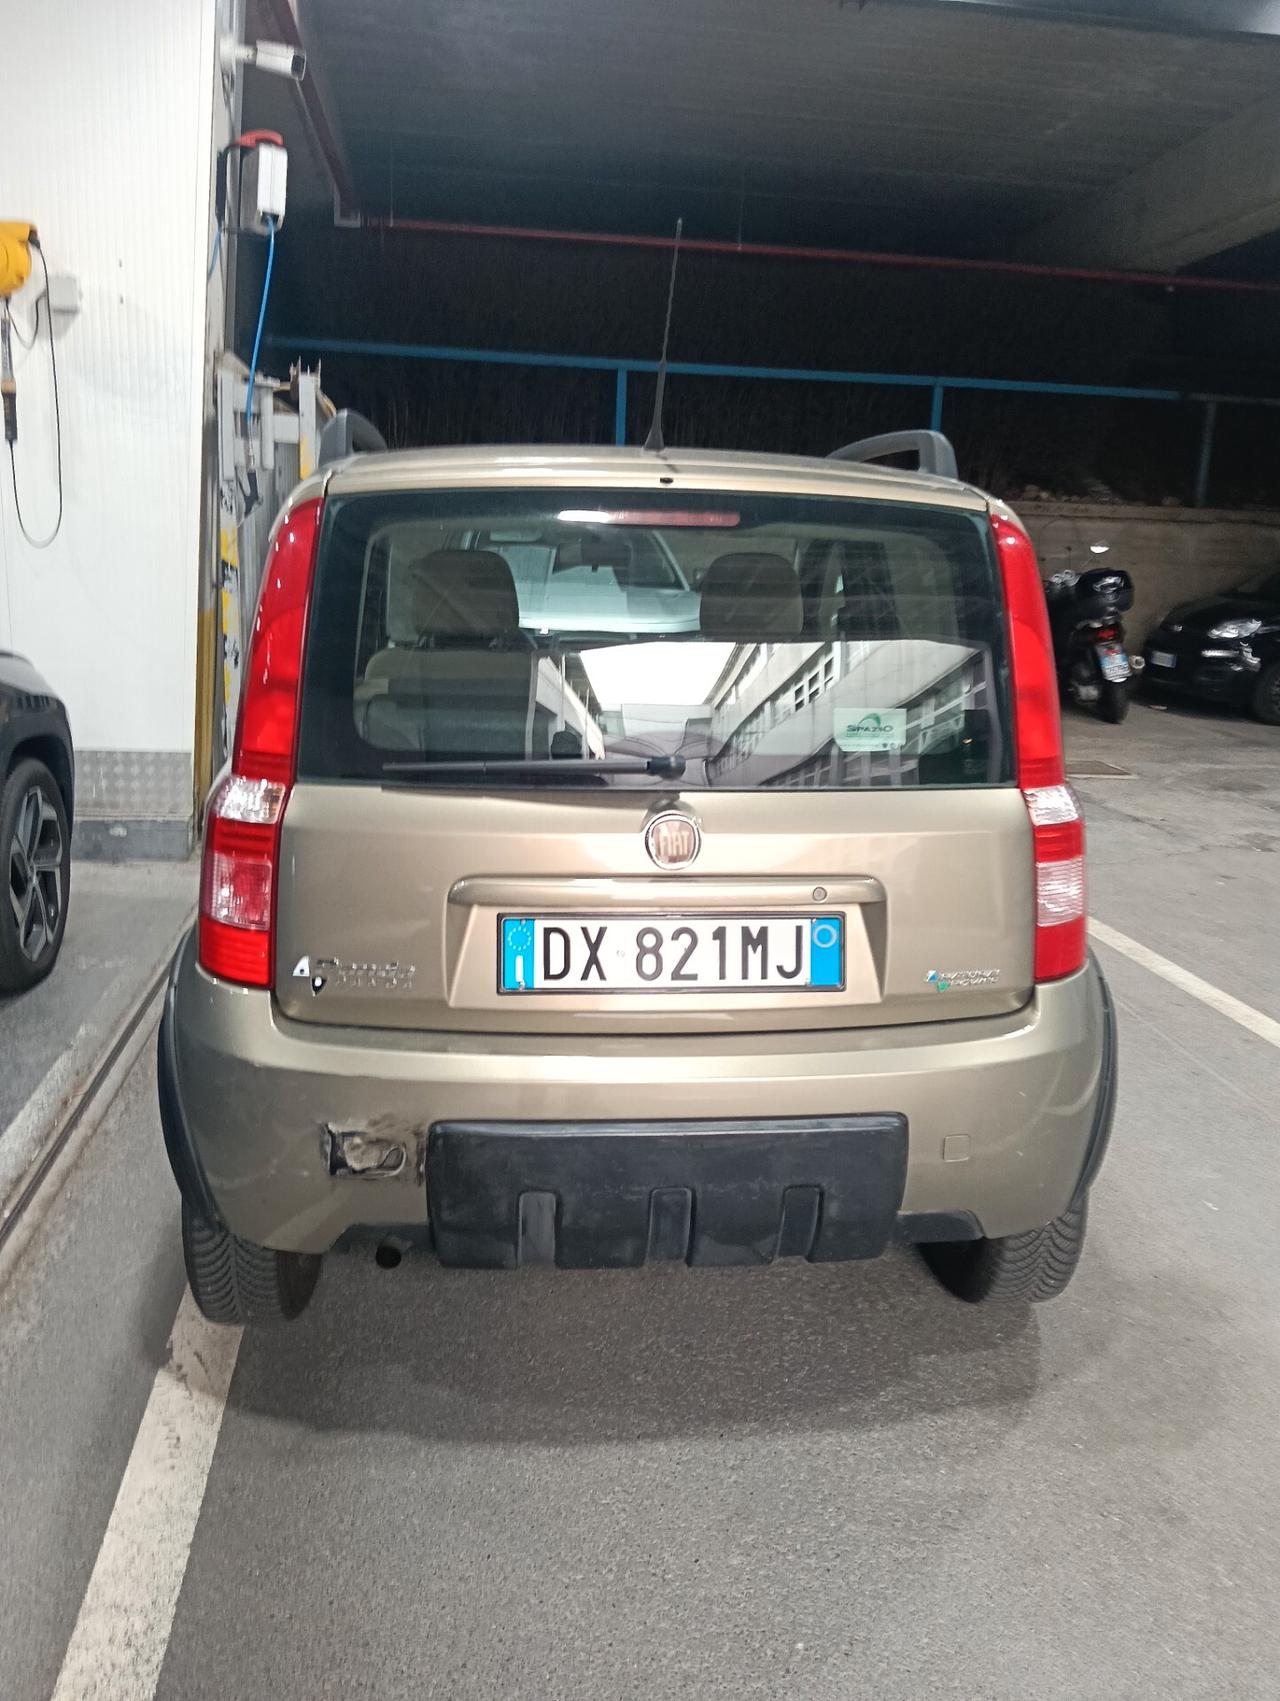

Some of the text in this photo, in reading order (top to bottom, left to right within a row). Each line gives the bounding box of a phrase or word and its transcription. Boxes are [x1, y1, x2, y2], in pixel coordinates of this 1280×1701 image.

[659, 829, 690, 855] FIAT
[543, 925, 803, 981] DX 821MJ
